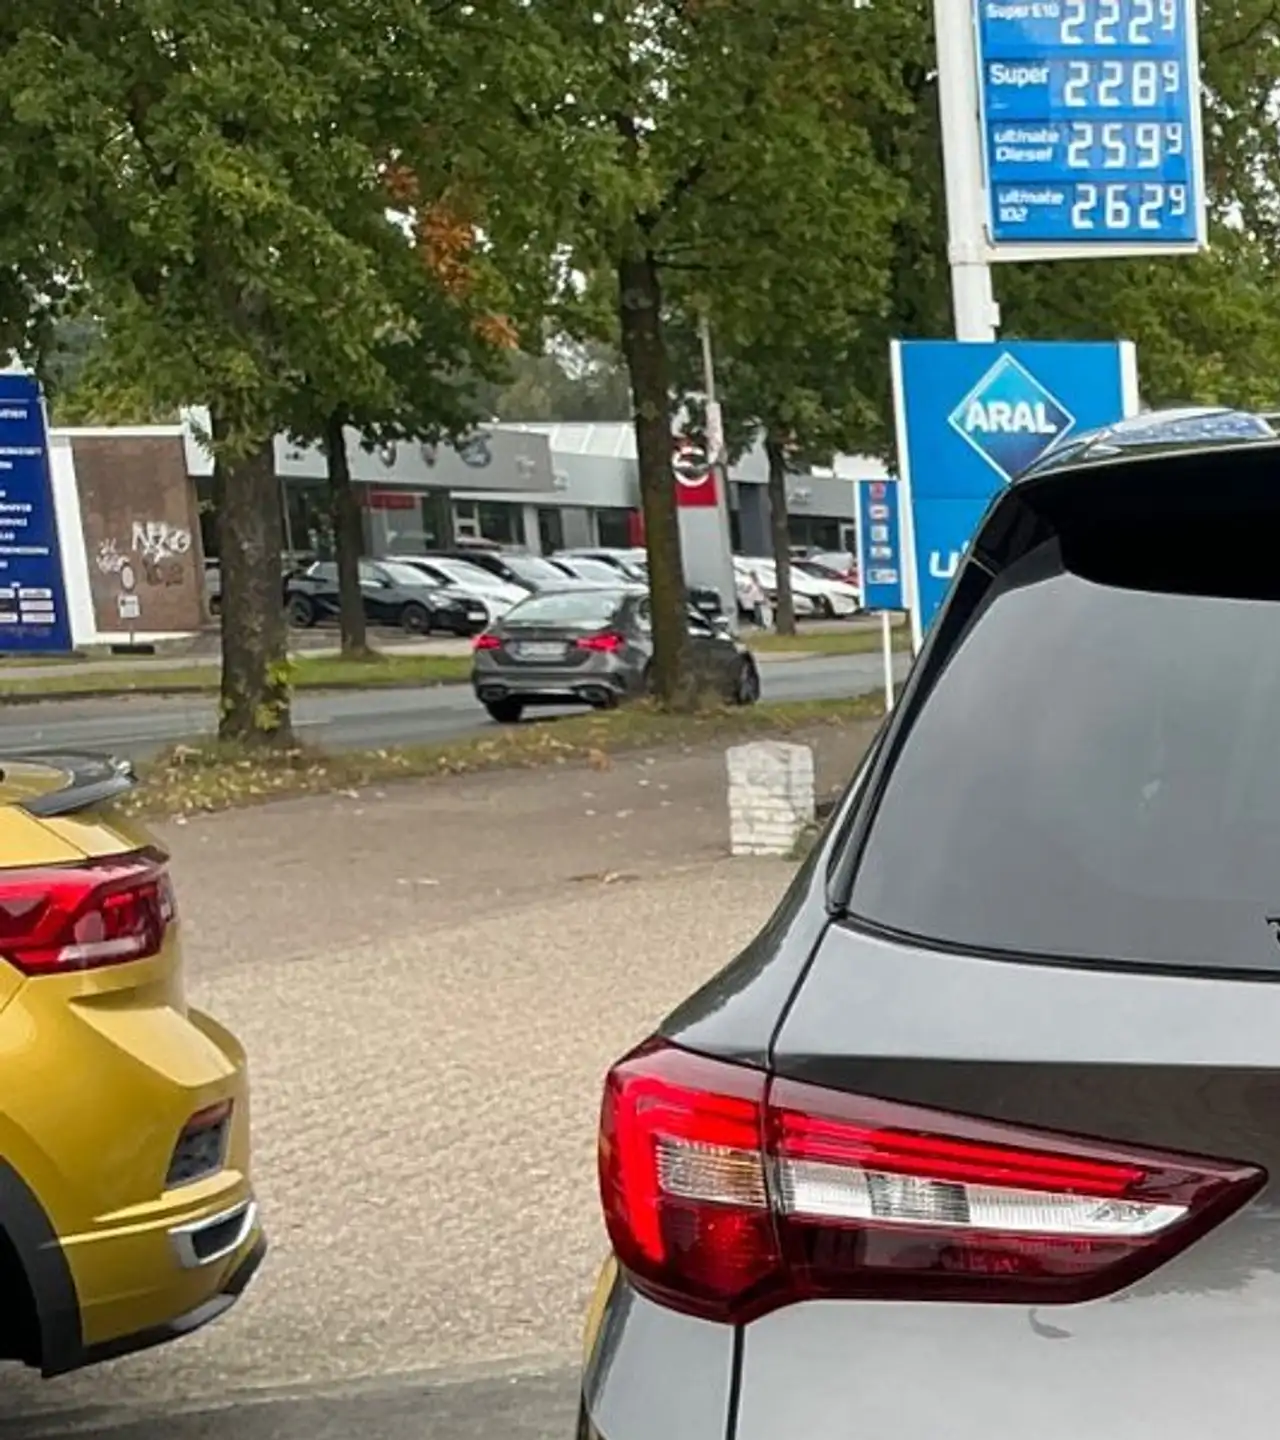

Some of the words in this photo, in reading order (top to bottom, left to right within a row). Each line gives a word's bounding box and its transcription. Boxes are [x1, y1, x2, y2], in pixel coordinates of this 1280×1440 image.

[989, 64, 1049, 88] Super
[996, 147, 1053, 162] Diesel
[964, 401, 1057, 433] ARAL
